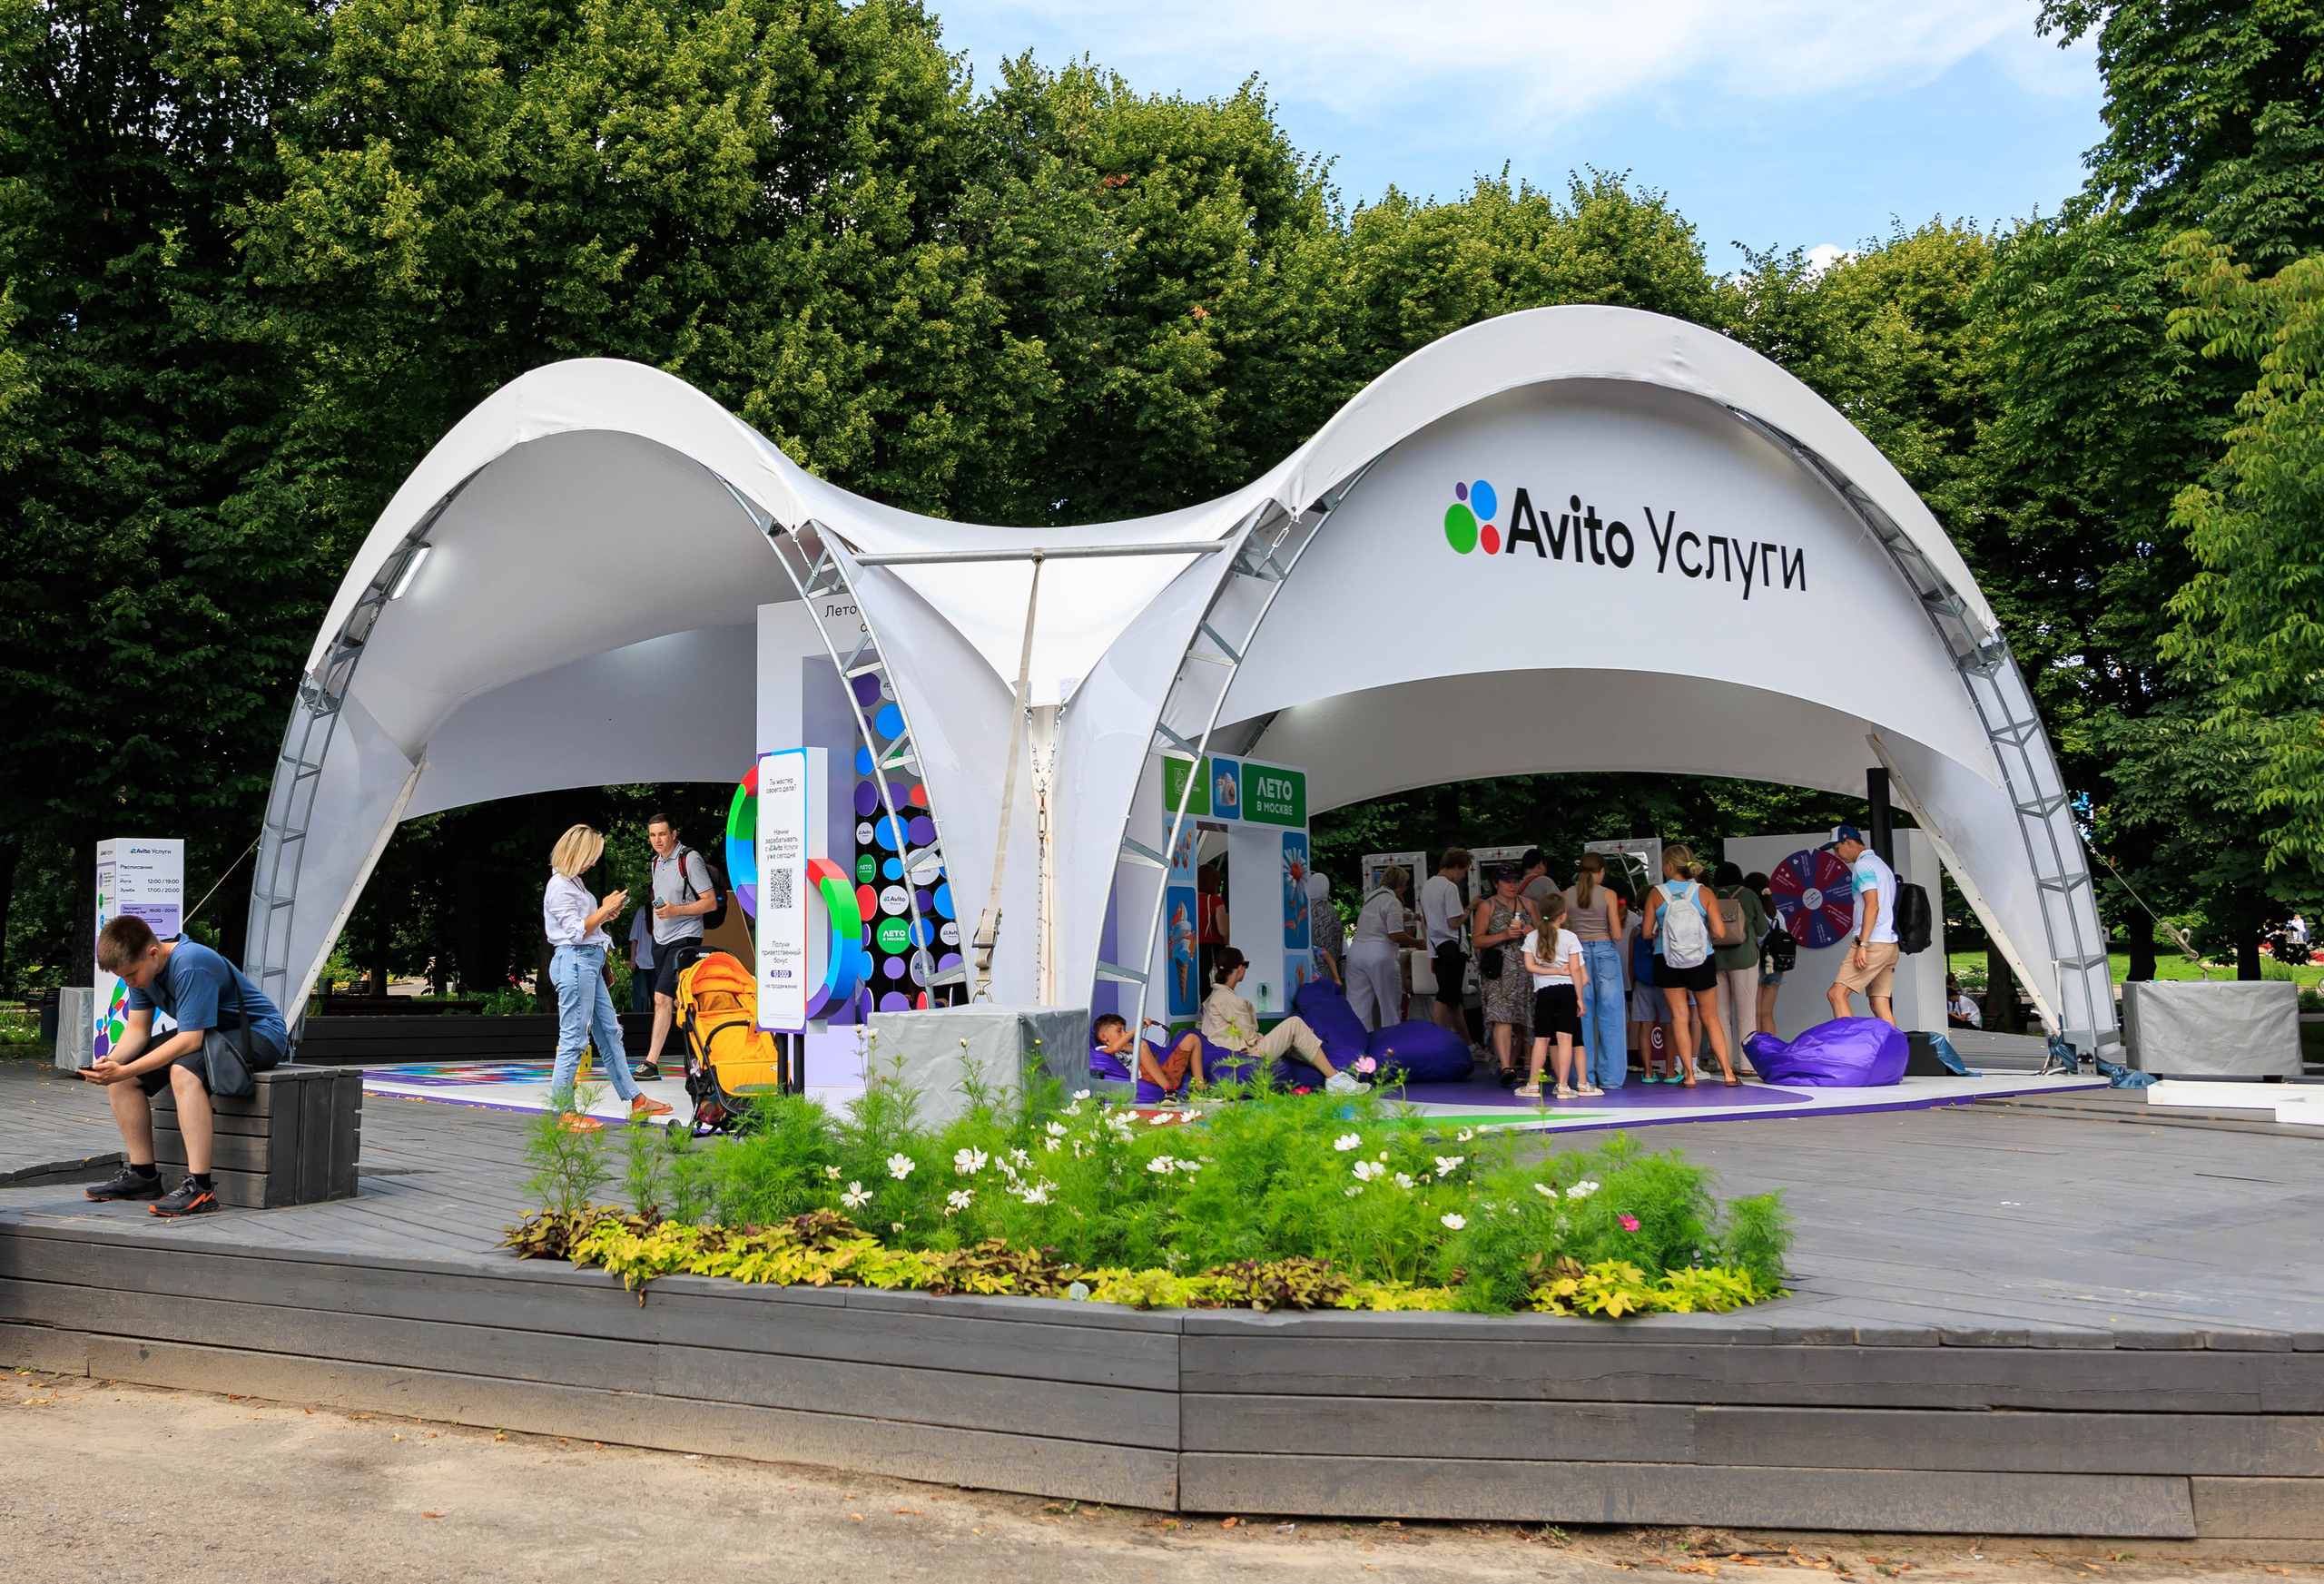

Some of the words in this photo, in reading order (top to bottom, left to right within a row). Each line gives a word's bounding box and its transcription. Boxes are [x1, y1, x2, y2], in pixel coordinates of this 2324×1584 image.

[1505, 487, 1634, 569] Avito
[1642, 506, 1807, 600] Услуги
[825, 605, 857, 618] Лето
[783, 784, 797, 792] дела?
[1257, 777, 1293, 801] ЛЕТО
[1256, 802, 1262, 812] В
[1264, 803, 1293, 815] МОСКВЕ
[765, 836, 798, 844] зарабатывать
[772, 940, 790, 949] Получи
[762, 949, 801, 957] приветственный
